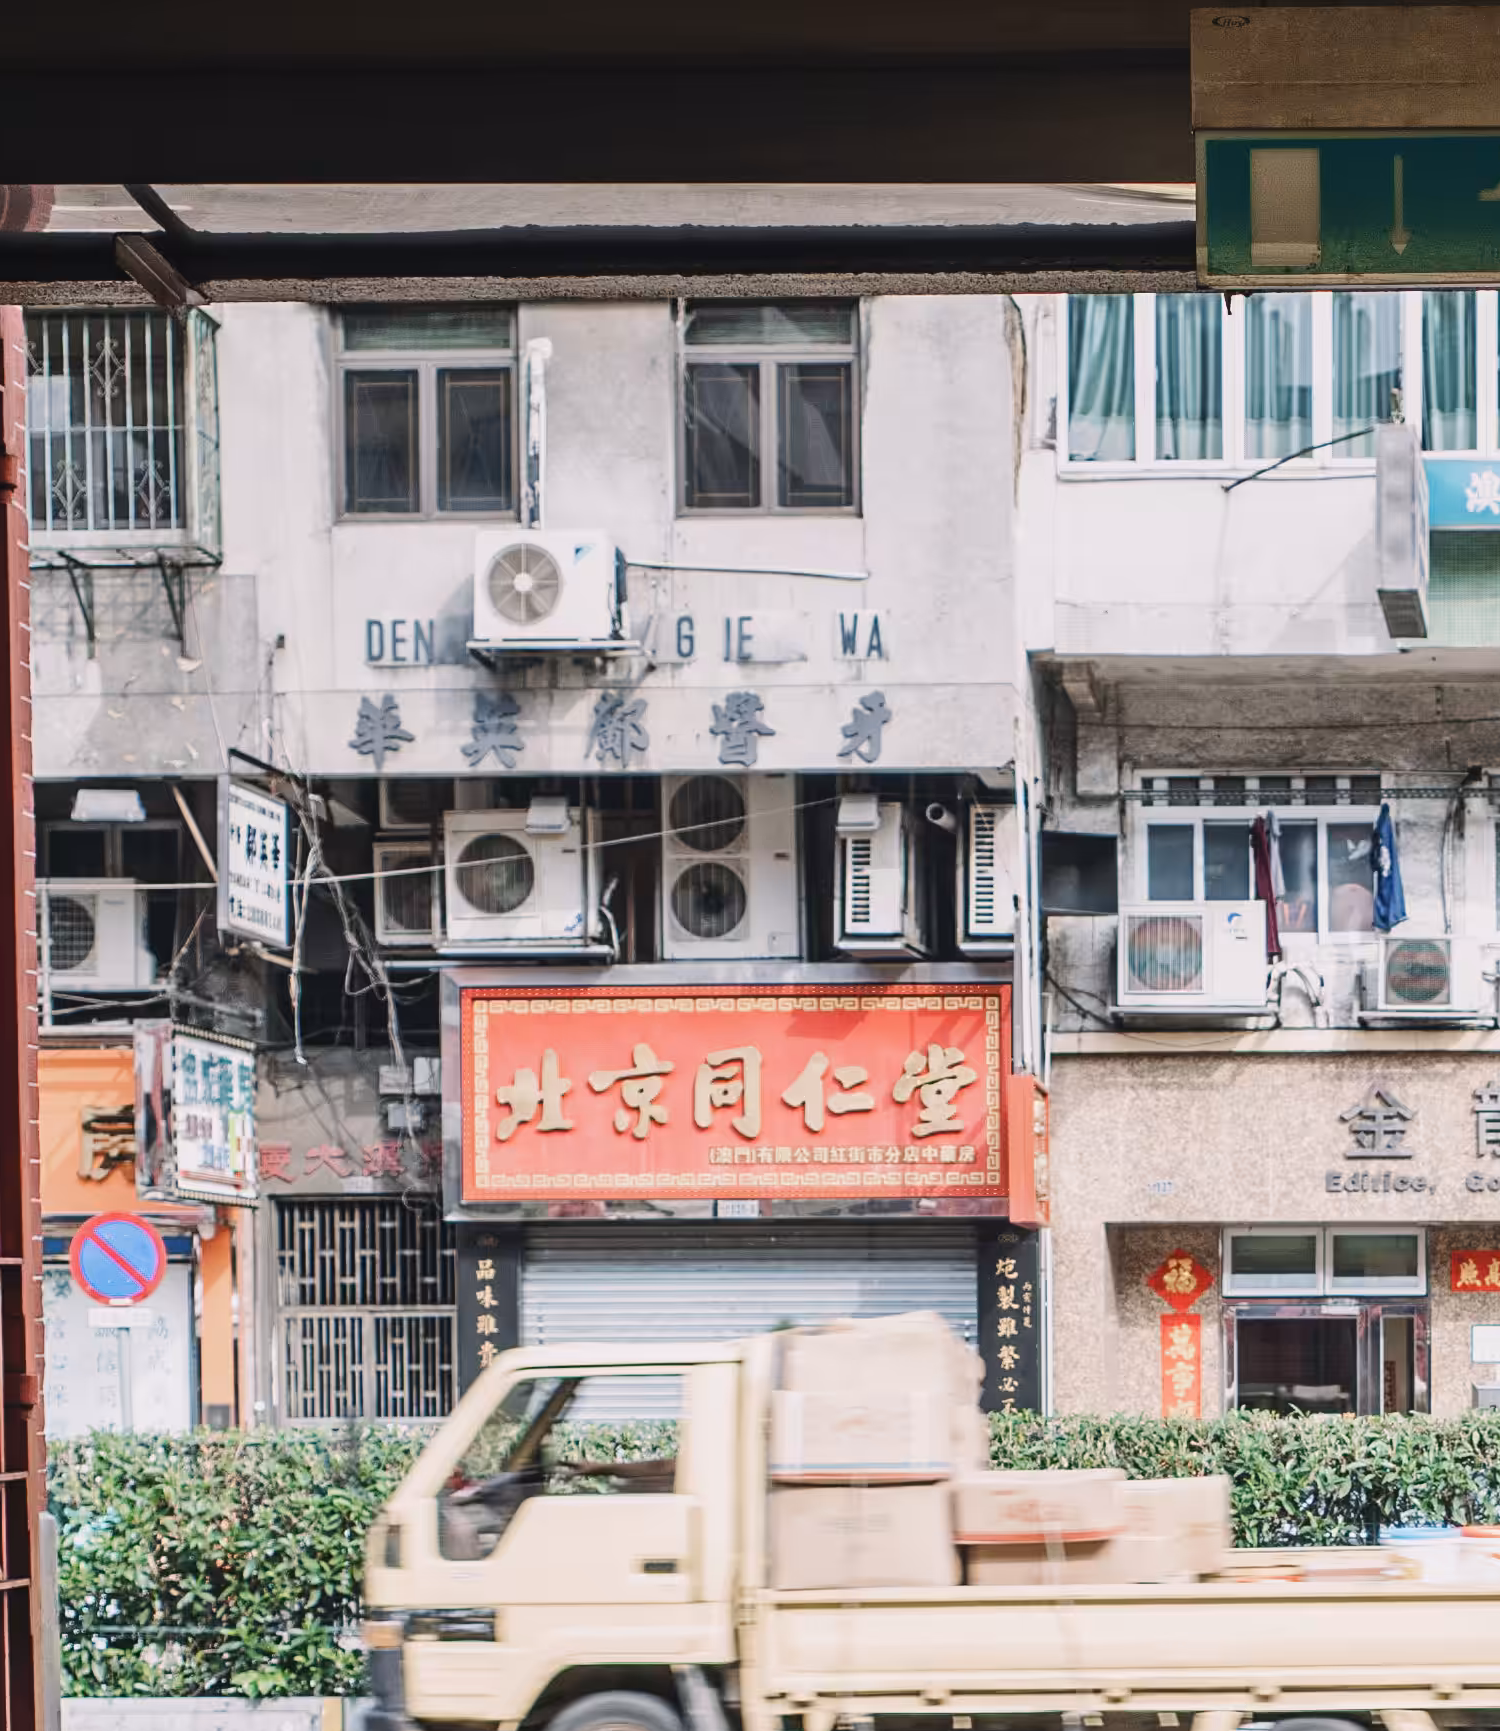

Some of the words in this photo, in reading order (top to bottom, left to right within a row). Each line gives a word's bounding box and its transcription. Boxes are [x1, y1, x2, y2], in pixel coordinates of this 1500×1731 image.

[839, 614, 884, 658] WA
[496, 1043, 978, 1142] 北京同仁堂
[1163, 1257, 1196, 1294] 福
